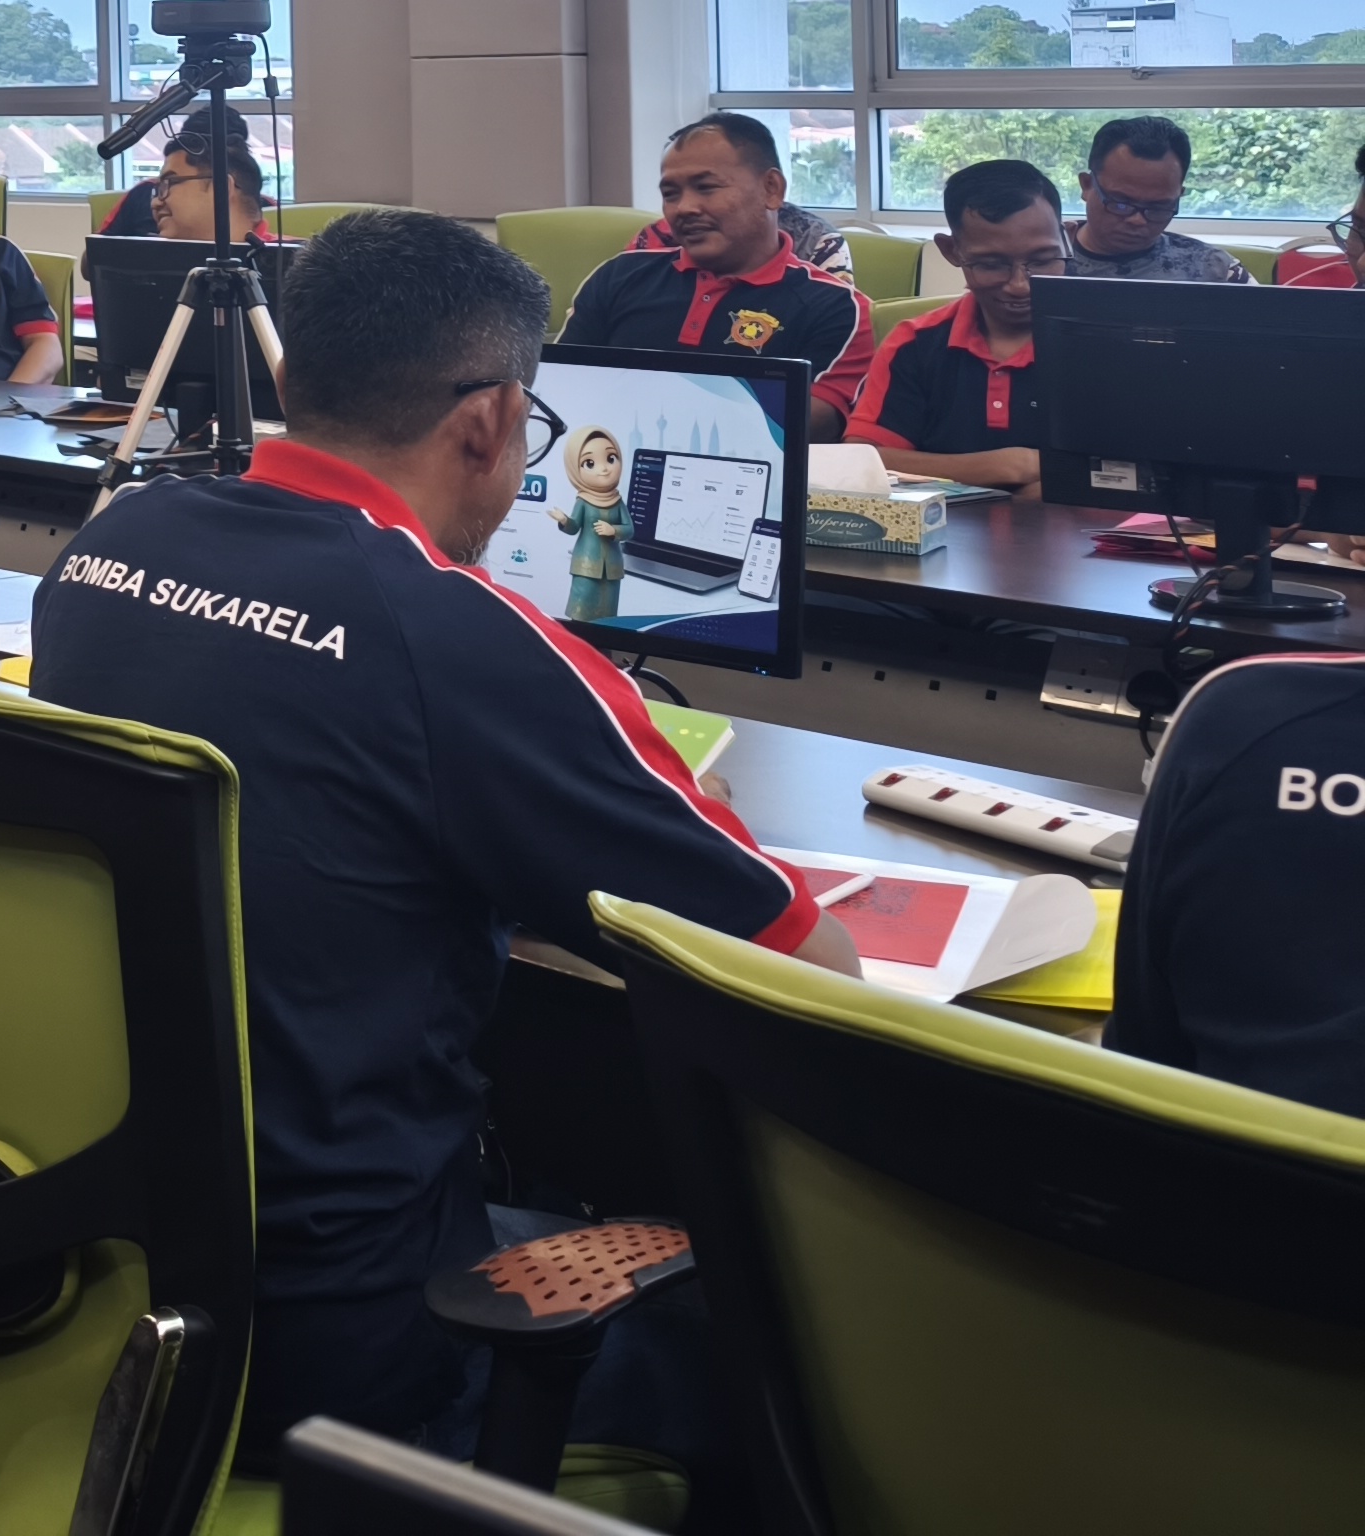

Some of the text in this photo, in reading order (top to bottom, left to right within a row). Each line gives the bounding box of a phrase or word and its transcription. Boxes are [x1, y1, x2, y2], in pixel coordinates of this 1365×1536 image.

[518, 479, 542, 498] 2.0
[806, 512, 869, 535] Superior
[58, 554, 346, 660] BOMBA SUKARELA
[1277, 766, 1365, 817] BO
